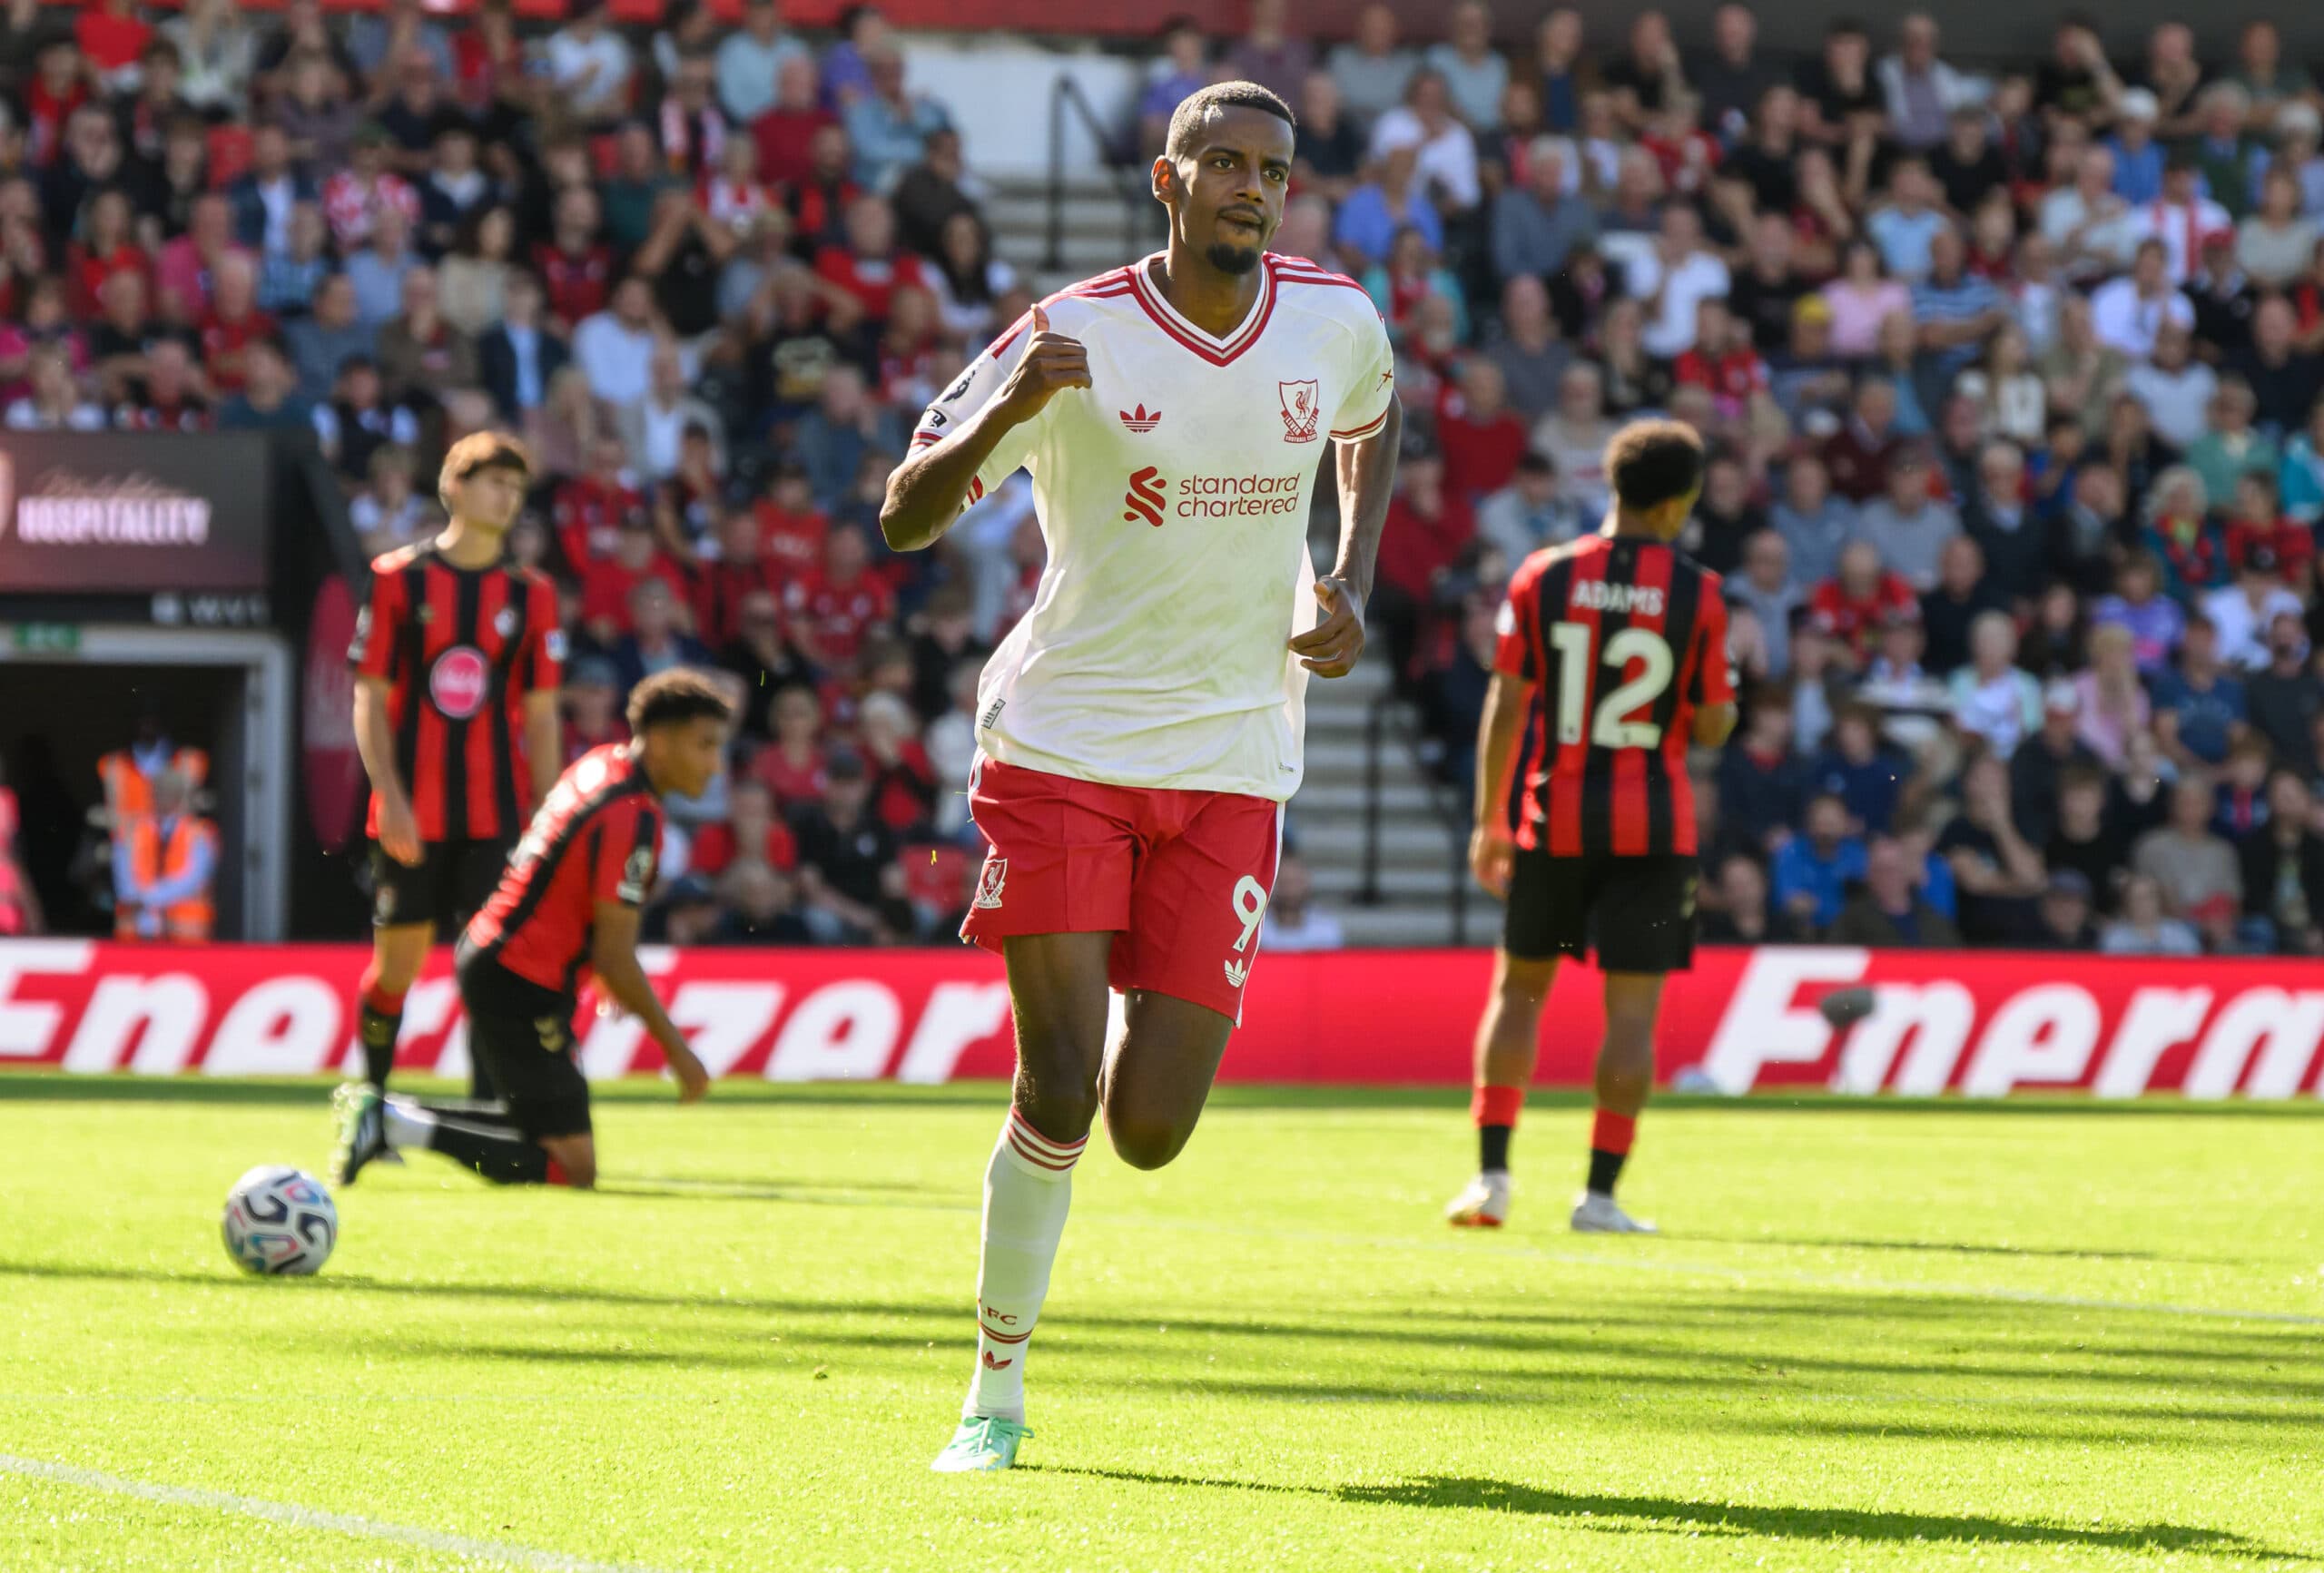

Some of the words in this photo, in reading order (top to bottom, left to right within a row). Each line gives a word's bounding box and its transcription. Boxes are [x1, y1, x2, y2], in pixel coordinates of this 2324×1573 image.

[1178, 472, 1301, 495] standard
[17, 497, 211, 545] HOSPITALITY
[1177, 492, 1299, 517] chartered
[1570, 580, 1664, 616] ADAMS
[1551, 620, 1674, 750] 12
[1233, 874, 1267, 953] 9
[980, 1301, 1018, 1325] FC
